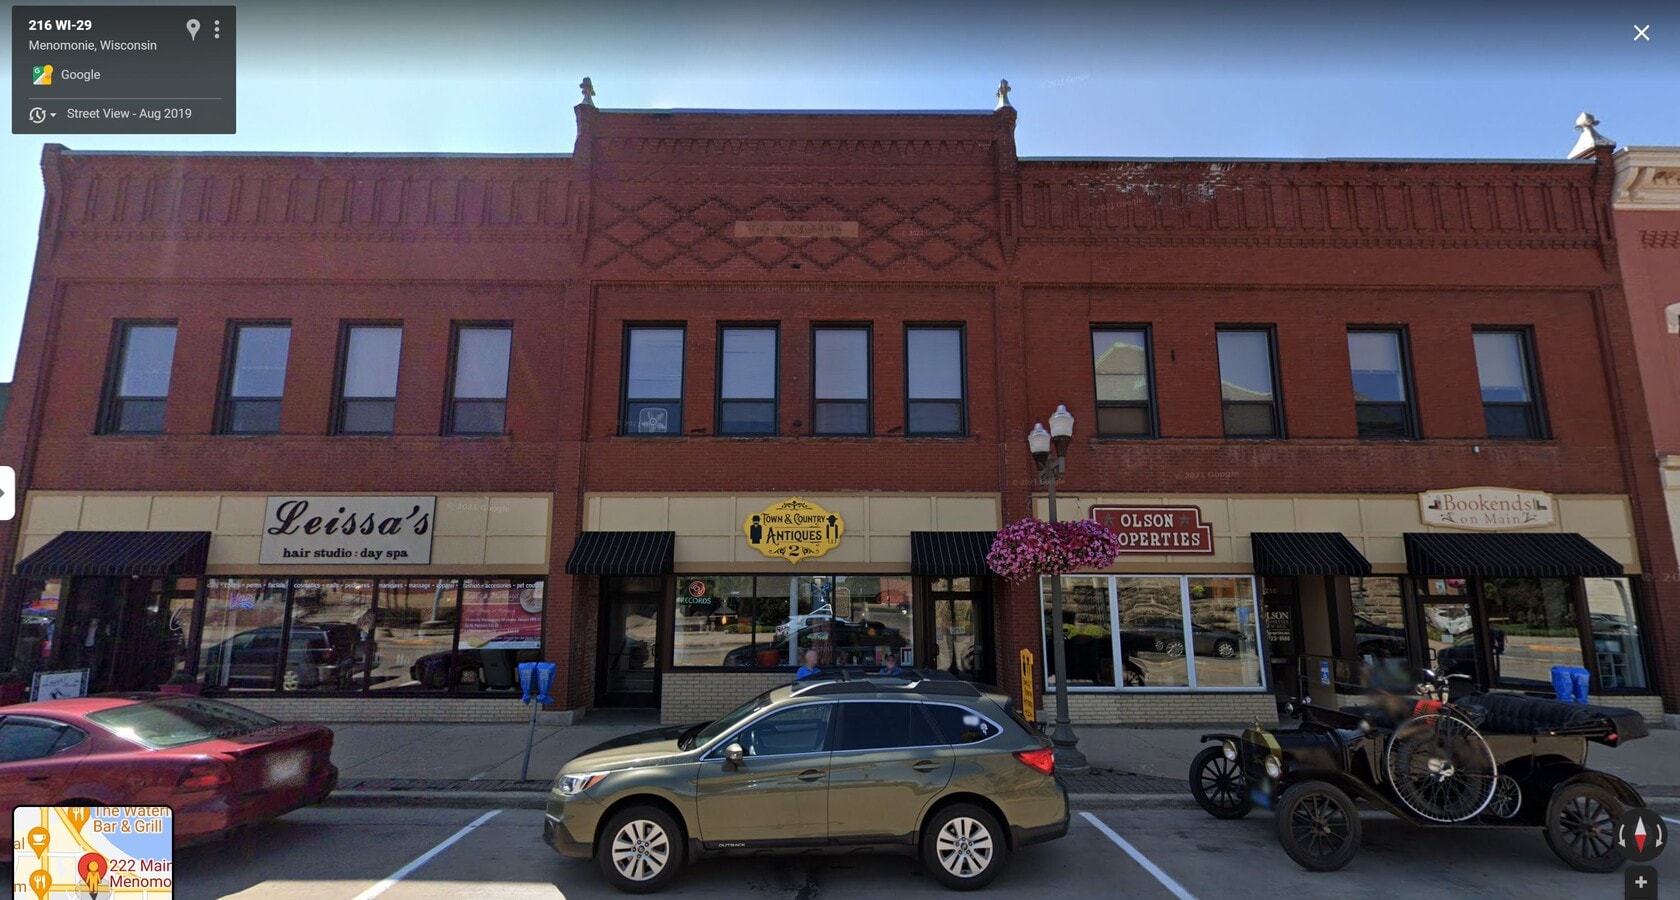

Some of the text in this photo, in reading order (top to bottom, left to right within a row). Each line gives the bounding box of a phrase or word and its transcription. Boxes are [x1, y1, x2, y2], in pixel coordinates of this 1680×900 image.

[1443, 494, 1532, 511] Bookends
[267, 500, 429, 535] Leissa's
[784, 513, 793, 525] &
[1120, 514, 1174, 527] OLSON
[1460, 514, 1520, 524] on Main
[1117, 532, 1200, 546] OPERTIES
[283, 548, 310, 558] hair
[314, 548, 352, 558] studio
[360, 548, 383, 560] day
[386, 550, 408, 560] spa
[789, 545, 800, 556] 2
[679, 597, 711, 605] RECORDS
